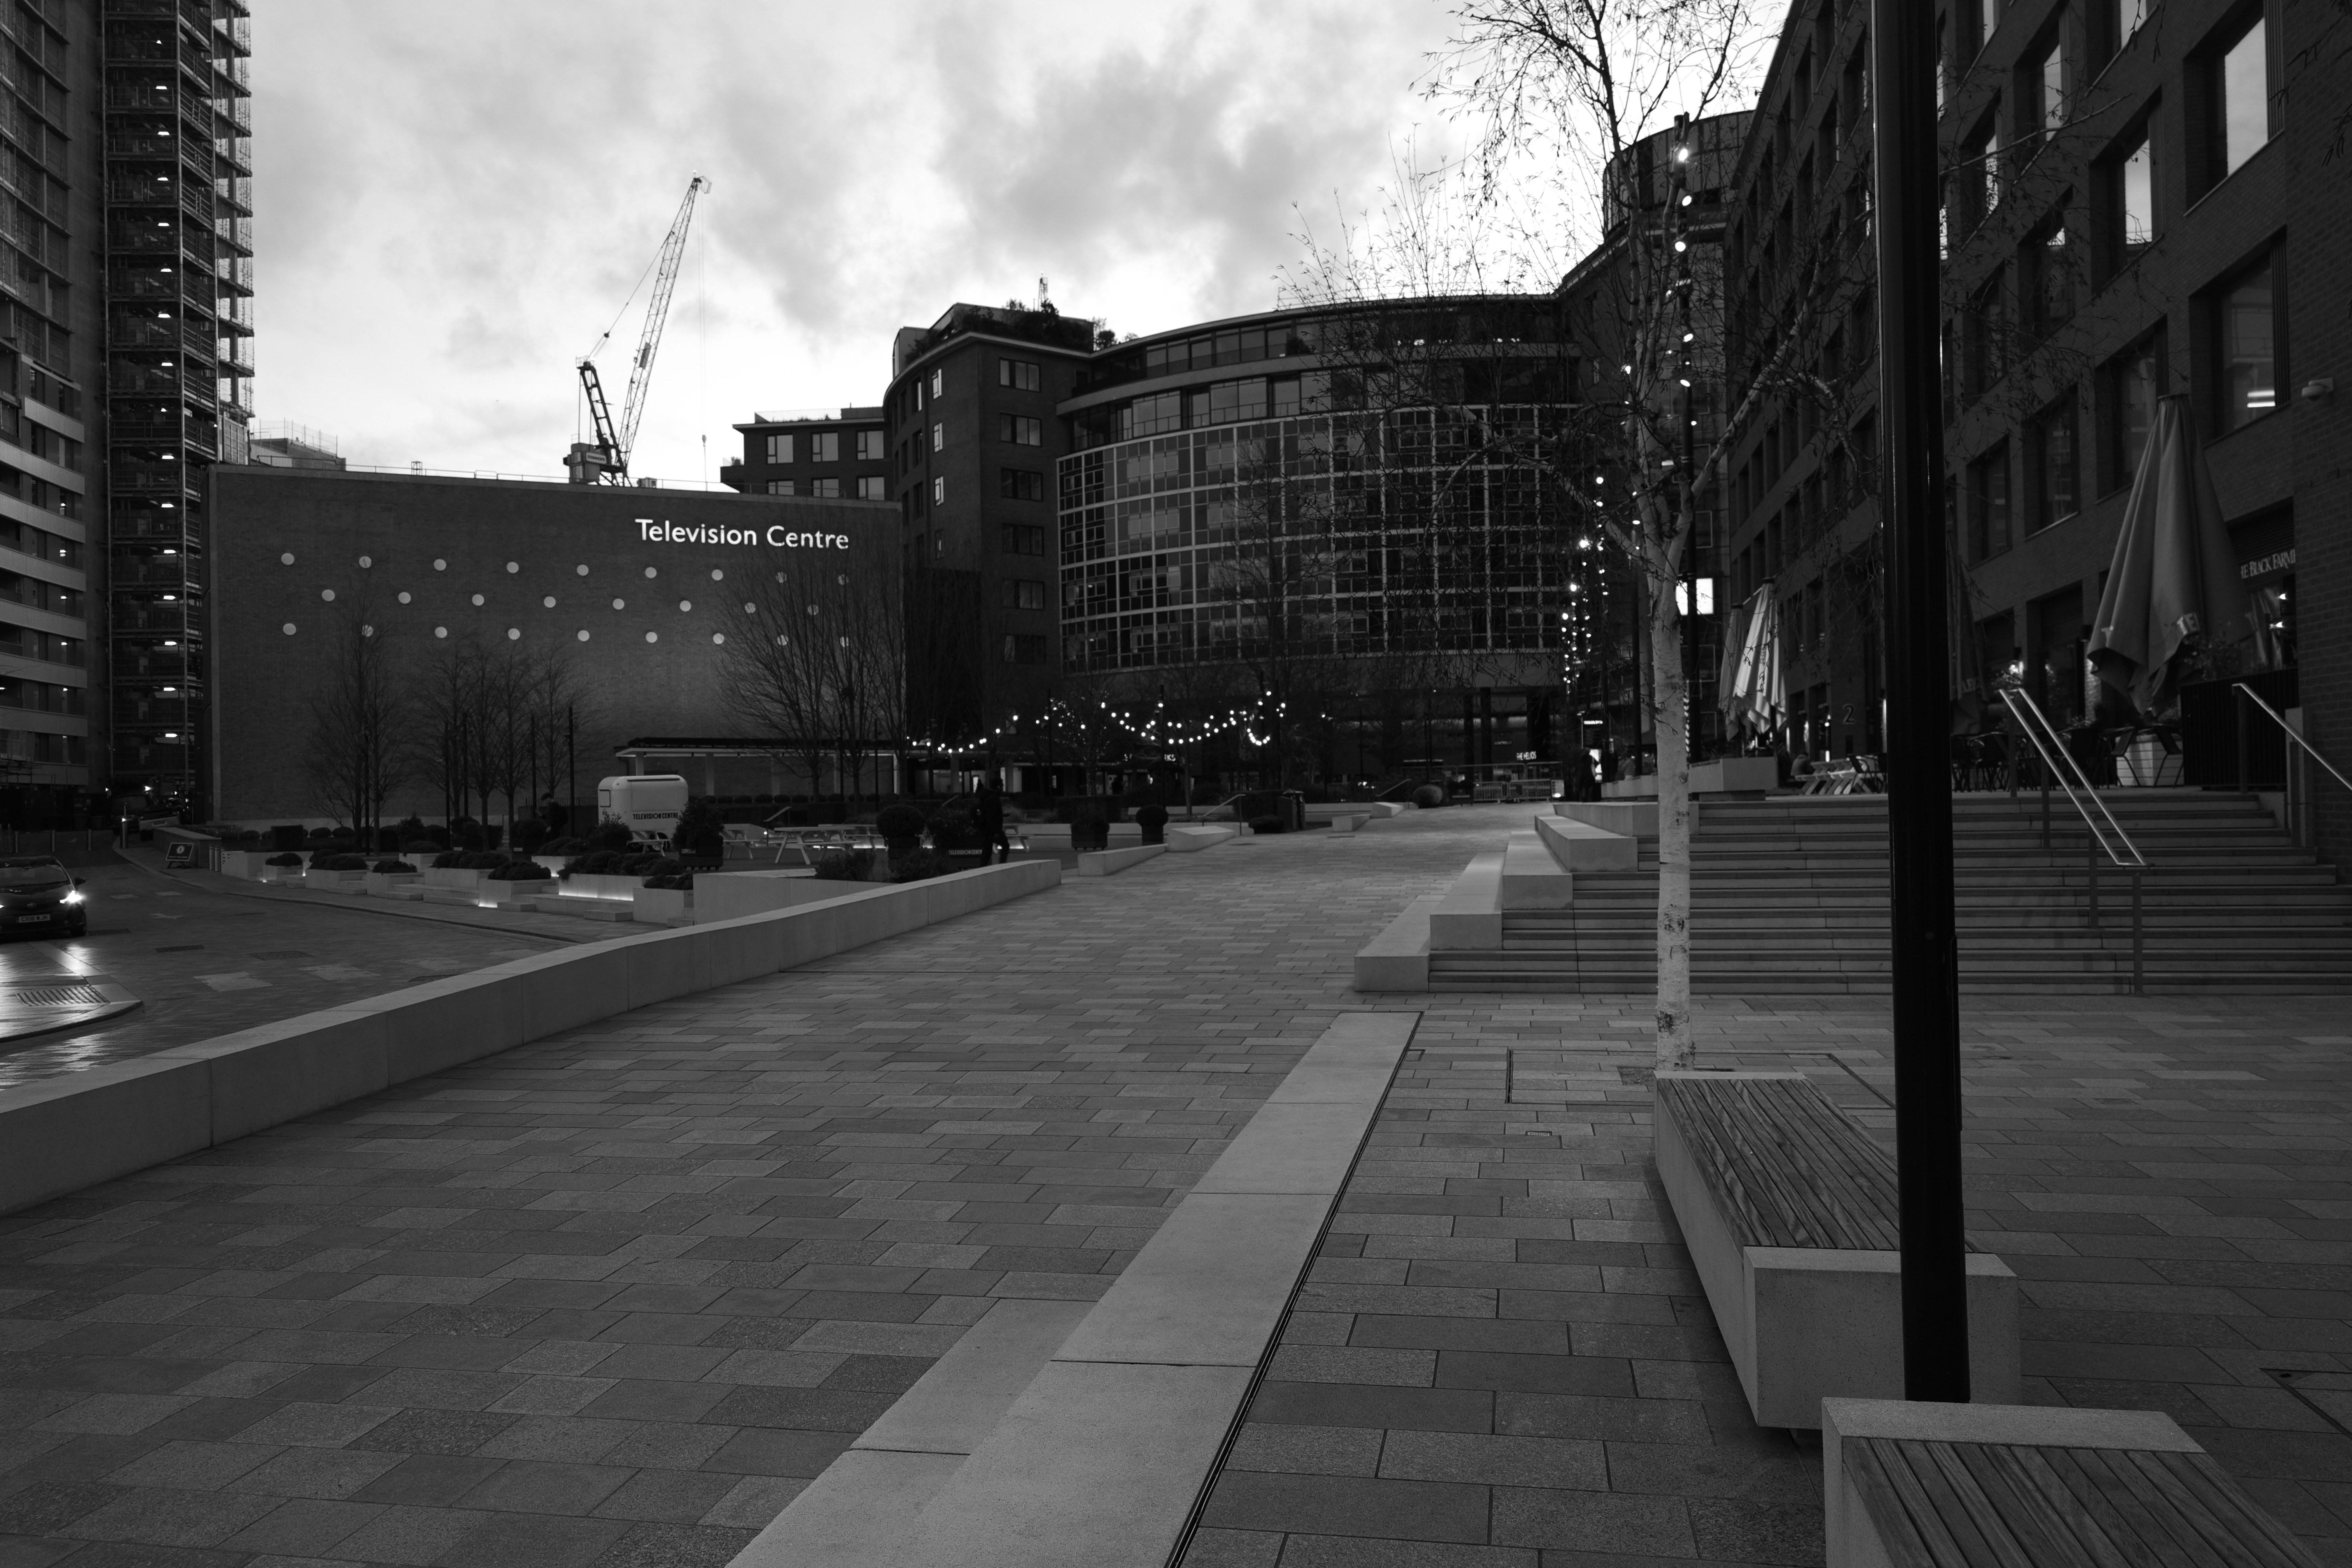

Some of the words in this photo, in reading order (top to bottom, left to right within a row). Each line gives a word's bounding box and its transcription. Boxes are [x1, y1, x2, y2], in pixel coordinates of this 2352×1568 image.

[635, 519, 757, 545] Television
[767, 526, 849, 549] Centre
[2249, 557, 2272, 577] BLACK
[1842, 703, 1855, 724] 2
